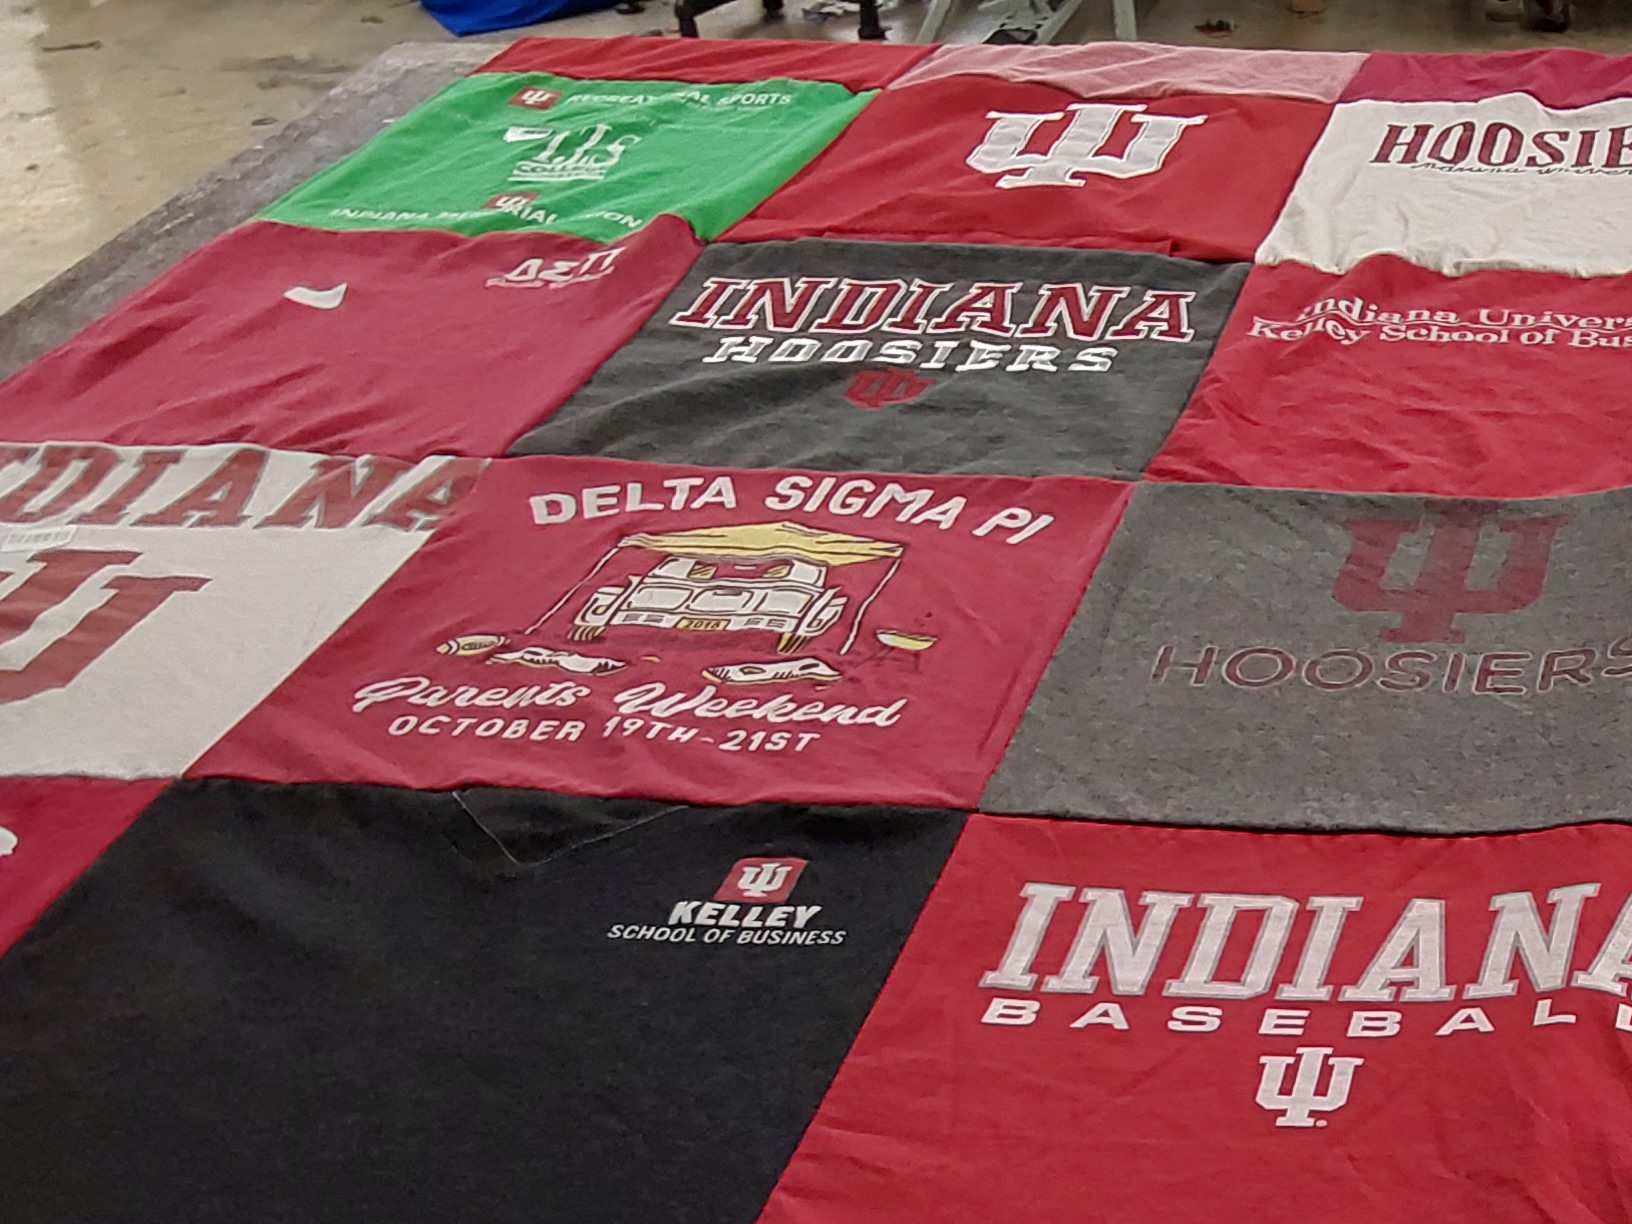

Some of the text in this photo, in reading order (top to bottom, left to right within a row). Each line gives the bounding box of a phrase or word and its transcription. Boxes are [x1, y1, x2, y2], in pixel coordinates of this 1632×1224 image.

[669, 276, 1197, 344] INDIANA
[1379, 323, 1509, 346] School
[1519, 327, 1556, 347] of
[702, 336, 1119, 374] HOOSIERS
[528, 475, 1054, 546] DELTA SIGMA PI
[351, 675, 908, 729] Parents Weekend
[387, 714, 587, 743] OCTOBER
[668, 900, 823, 930] KELLEY
[607, 924, 847, 946] SCHOOL OF BUSINESS
